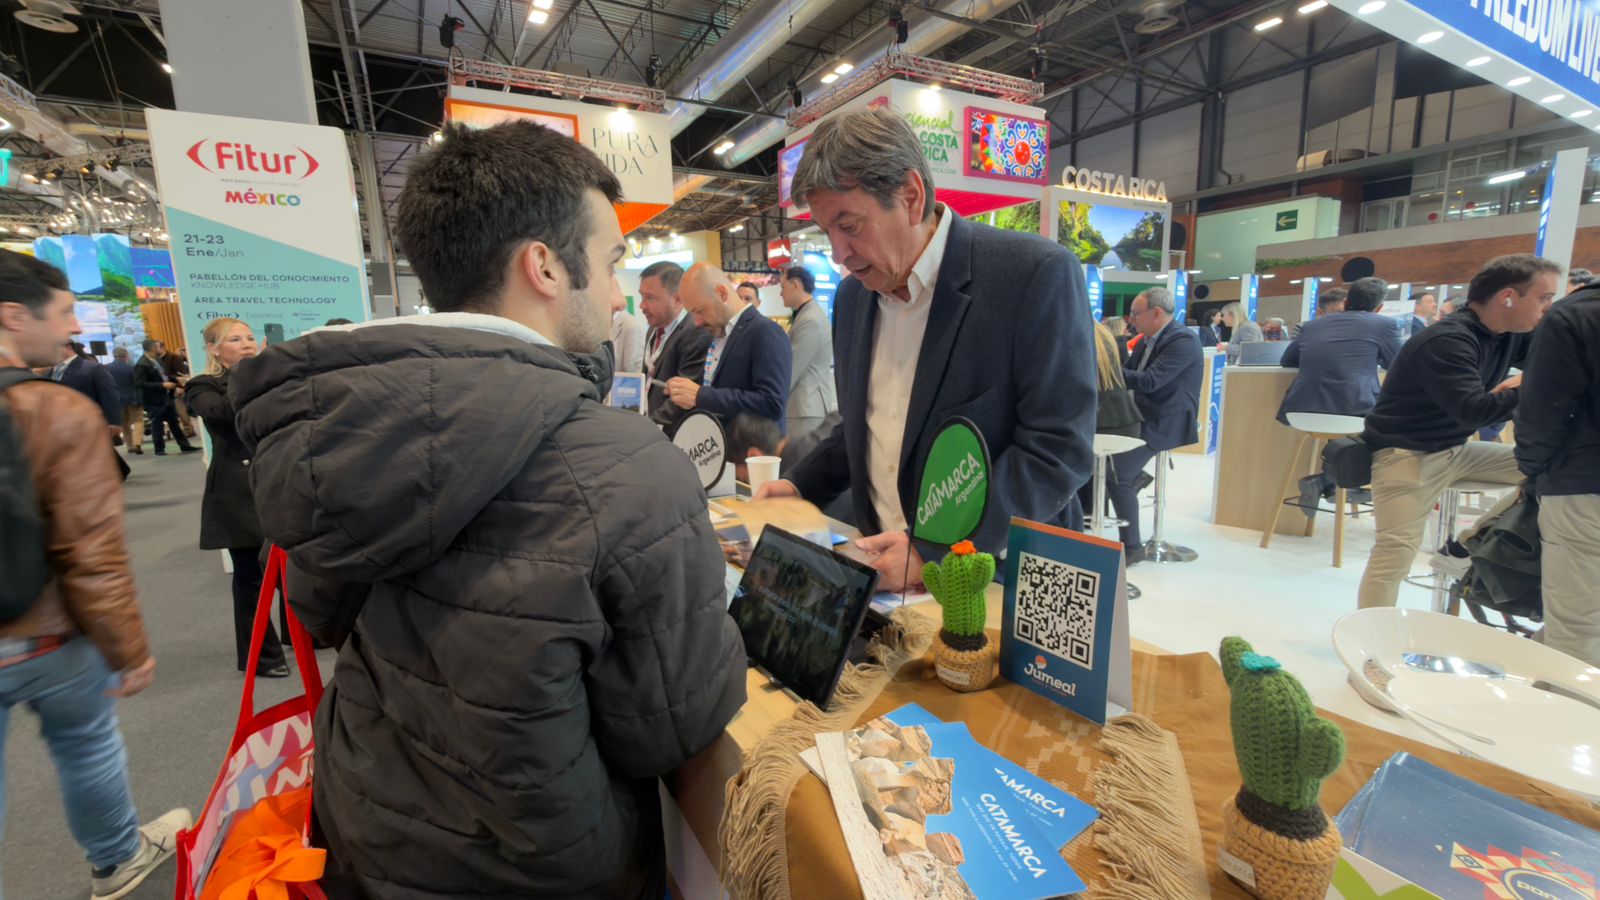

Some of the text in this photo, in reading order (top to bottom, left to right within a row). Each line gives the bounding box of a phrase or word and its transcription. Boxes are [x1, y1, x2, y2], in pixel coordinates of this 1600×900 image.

[592, 127, 658, 158] PURA
[919, 130, 958, 149] COSTA
[214, 142, 297, 175] Fitur
[600, 152, 643, 175] IDA
[1061, 165, 1168, 202] COSTA RICA
[183, 233, 225, 245] 21-23
[185, 246, 245, 258] Ene/Jan
[189, 272, 350, 283] PABELLÓN DEL CONOCIMIENTO
[190, 281, 280, 290] KNOWLEDGE HUB
[194, 296, 337, 305] ÁREA TRAVEL TECHNOLOGY
[917, 451, 980, 525] CATAMARCA
[955, 471, 984, 506] Argentina
[1024, 662, 1076, 697] Jumeal
[979, 793, 1047, 878] CATAMARCA
